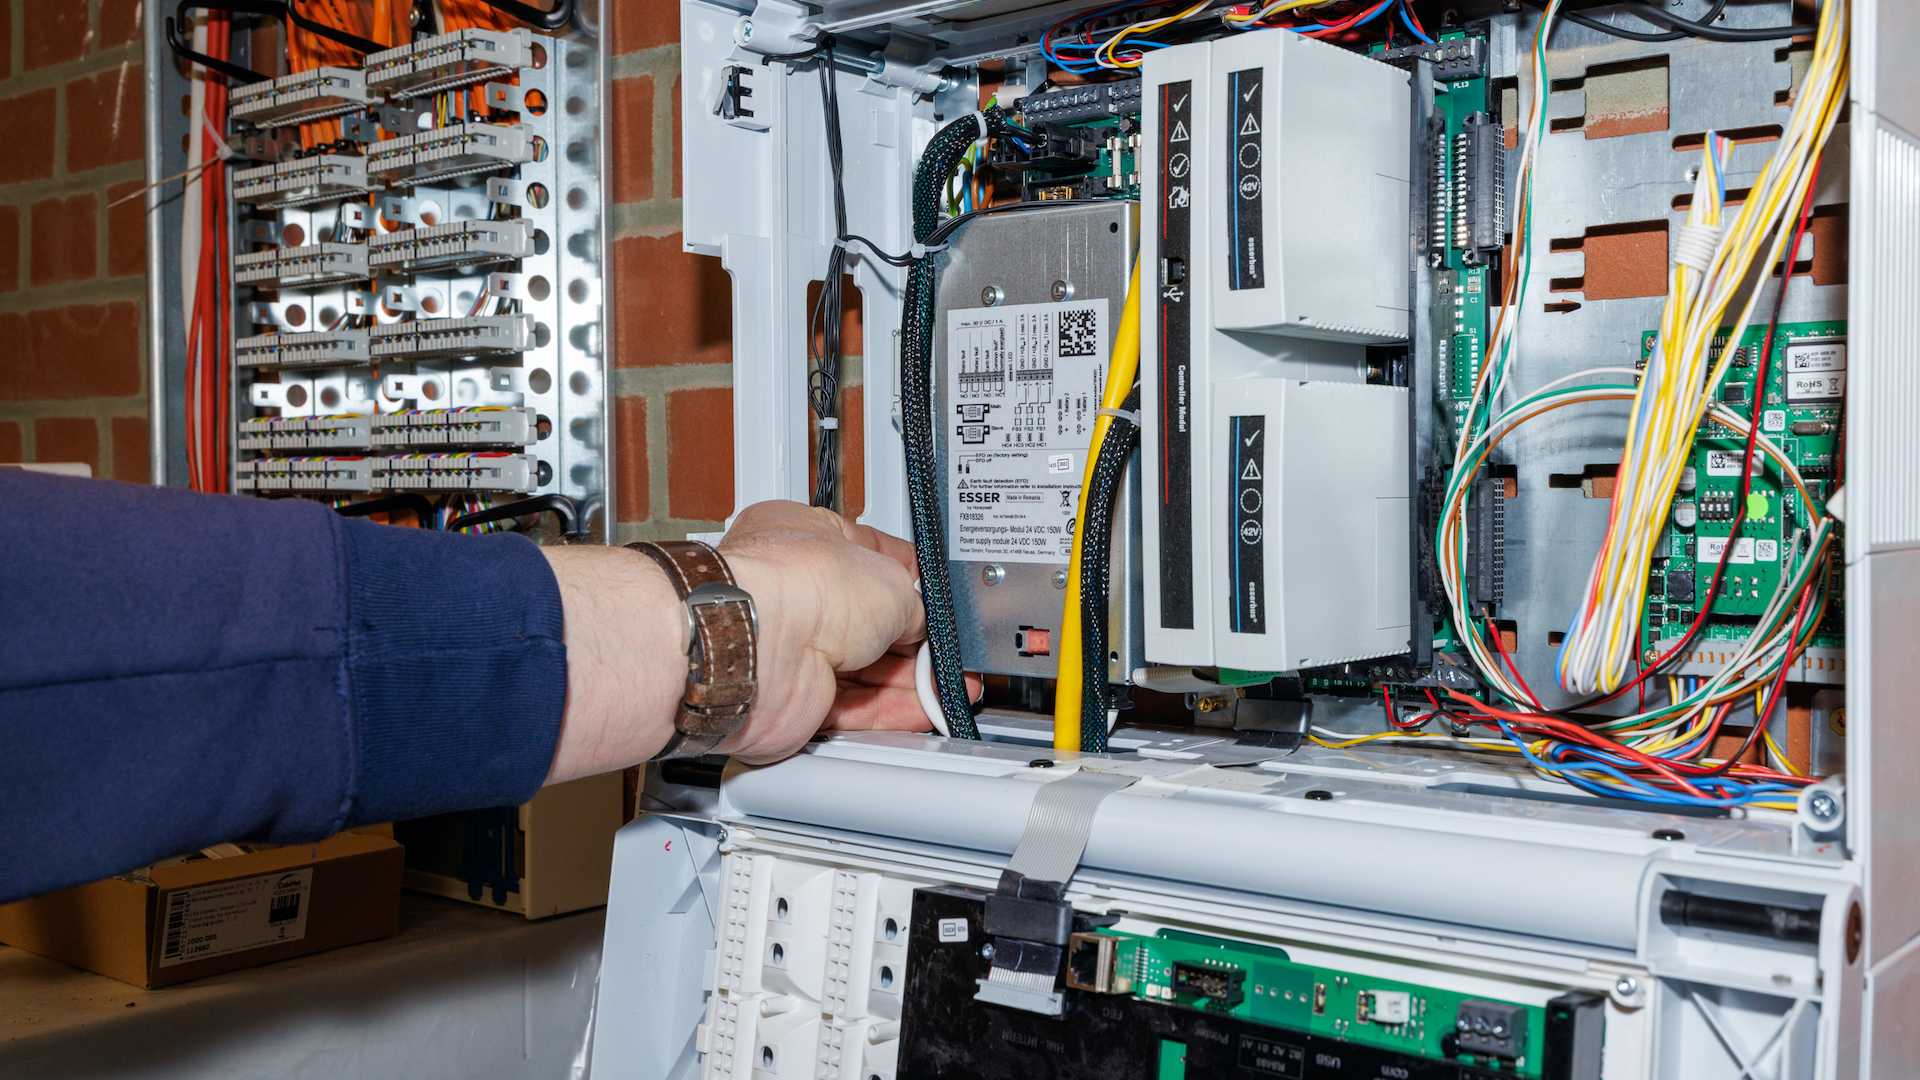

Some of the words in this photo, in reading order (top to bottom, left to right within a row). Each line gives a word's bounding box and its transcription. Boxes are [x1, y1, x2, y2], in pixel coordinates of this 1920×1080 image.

[1452, 81, 1470, 89] PL13
[1242, 182, 1258, 192] 42V
[1178, 364, 1187, 405] Controller
[1796, 380, 1823, 388] RoHS
[1178, 406, 1187, 433] Modul
[959, 492, 1000, 503] ESSER
[959, 512, 984, 521] FX818326
[959, 524, 1009, 534] Energieversorgungs-
[1009, 525, 1025, 533] Modul
[1025, 525, 1033, 534] 24
[1033, 525, 1046, 534] VDC
[1046, 526, 1062, 534] 150W
[1242, 527, 1259, 536] 42V
[959, 536, 975, 544] Power
[975, 537, 991, 546] supply
[992, 537, 1010, 545] module
[1018, 538, 1031, 546] VDC
[1031, 538, 1046, 546] 150W
[278, 880, 301, 889] CobiNet
[187, 936, 204, 945] 1020
[204, 933, 218, 942] 055
[1102, 1006, 1124, 1021] FEC
[1001, 1029, 1038, 1048] INTERN
[1194, 1028, 1230, 1045] Printer
[1272, 1044, 1286, 1057] A2
[1315, 1053, 1342, 1070] USB
[1380, 1064, 1409, 1080] com
